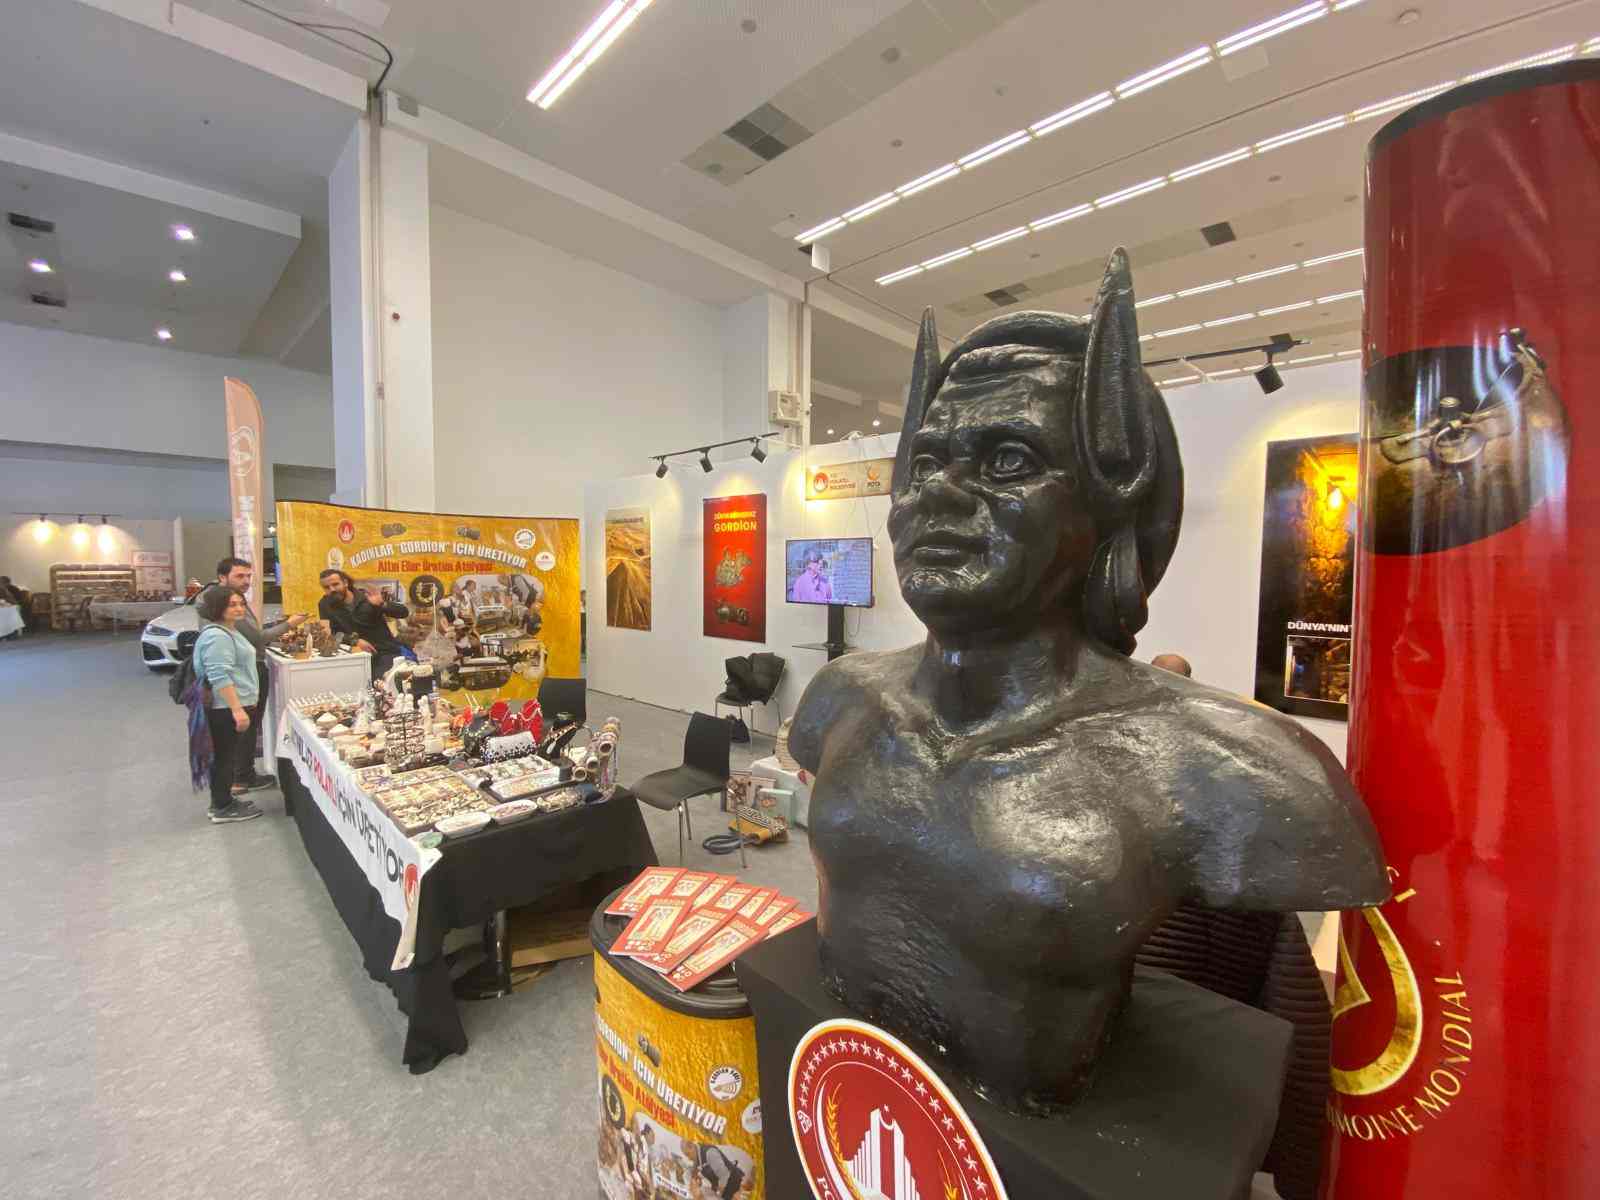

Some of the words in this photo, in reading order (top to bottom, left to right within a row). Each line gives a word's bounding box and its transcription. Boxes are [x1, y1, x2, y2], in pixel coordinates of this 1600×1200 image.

[350, 543, 395, 568] KADINLAR
[1287, 620, 1349, 633] DÜNYA'NIN
[1414, 970, 1472, 1120] MONDIAL
